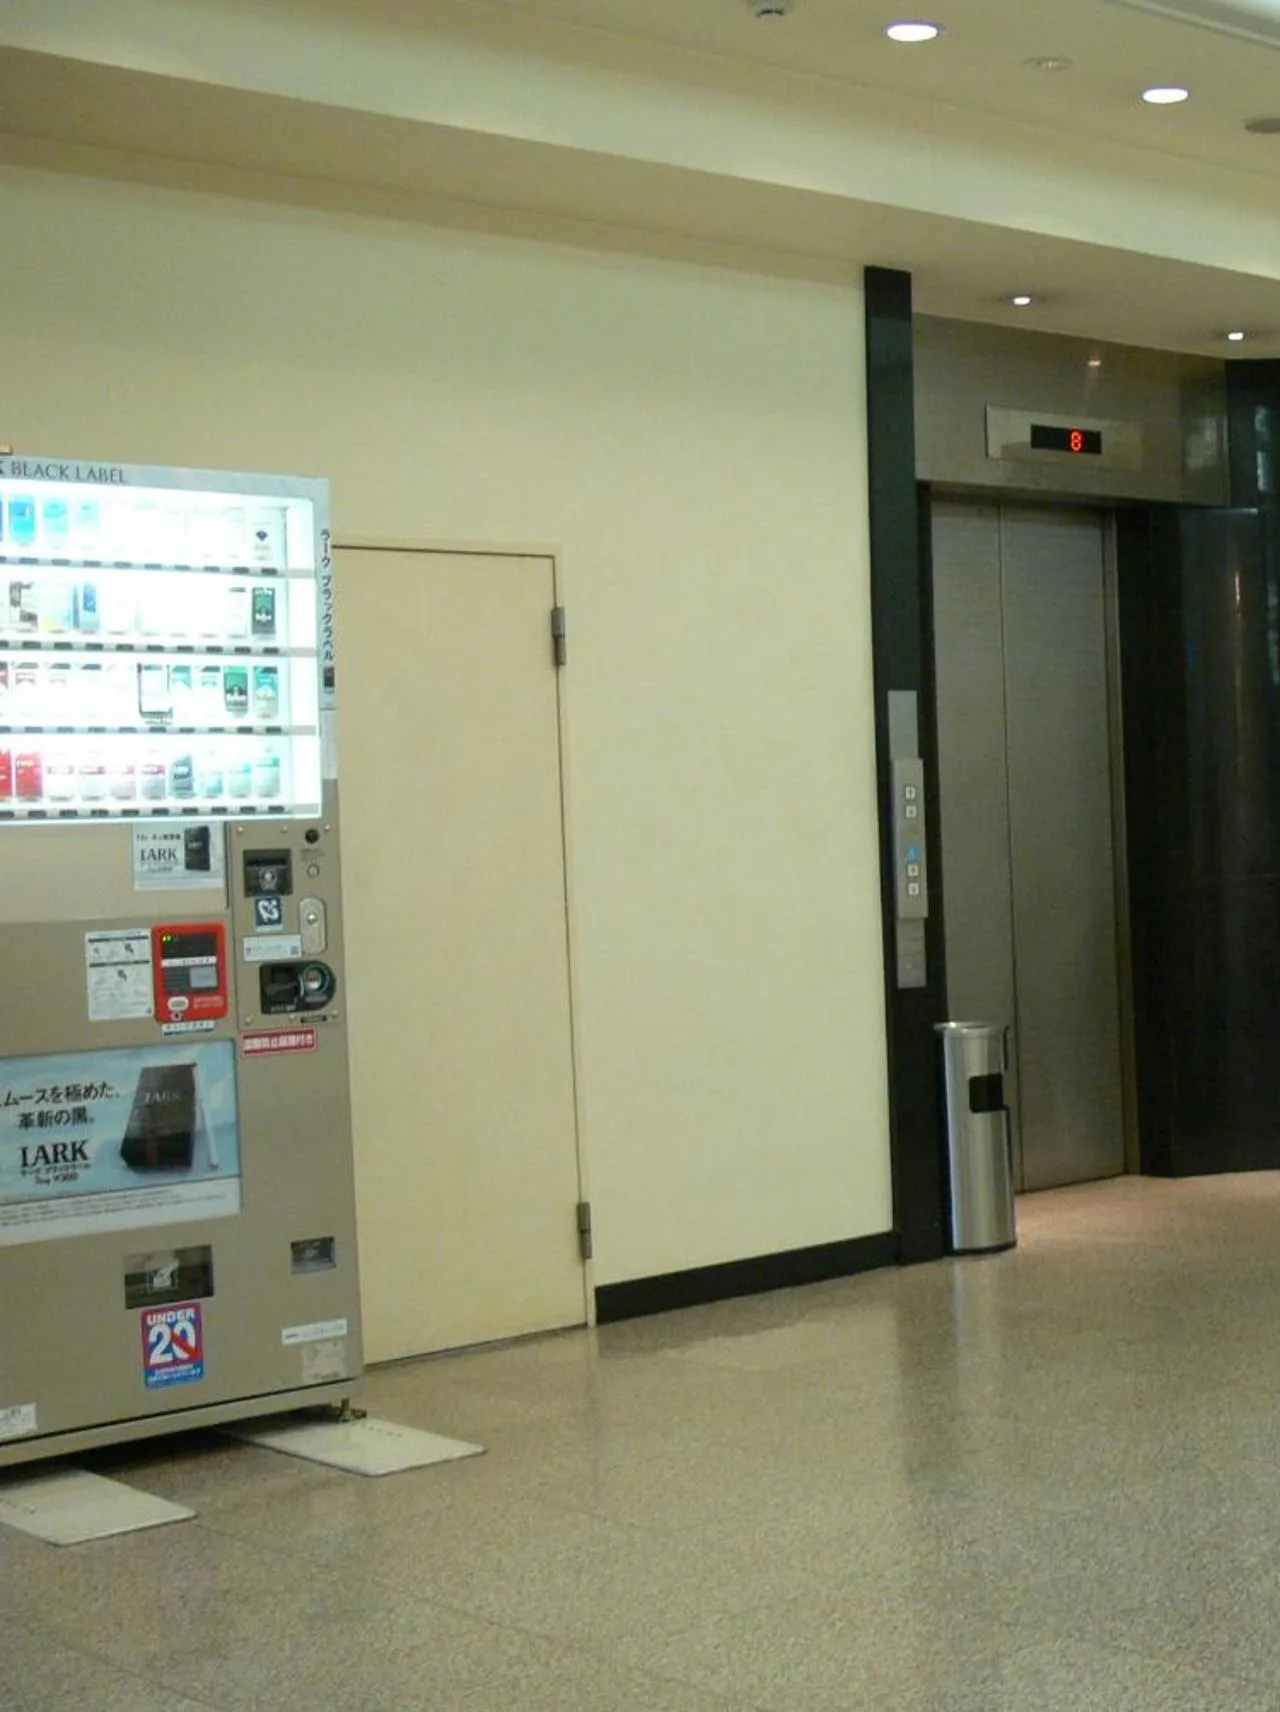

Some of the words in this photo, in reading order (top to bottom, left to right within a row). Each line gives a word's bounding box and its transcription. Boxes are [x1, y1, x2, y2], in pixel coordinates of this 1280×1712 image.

[11, 461, 70, 480] BLACK
[75, 464, 127, 485] LABEL
[320, 529, 331, 568] ラーク
[140, 848, 178, 861] LARK
[0, 1081, 120, 1106] ムースを極めた。
[20, 1140, 89, 1168] LARK
[147, 1308, 196, 1326] UNDER
[149, 1320, 196, 1366] 20
